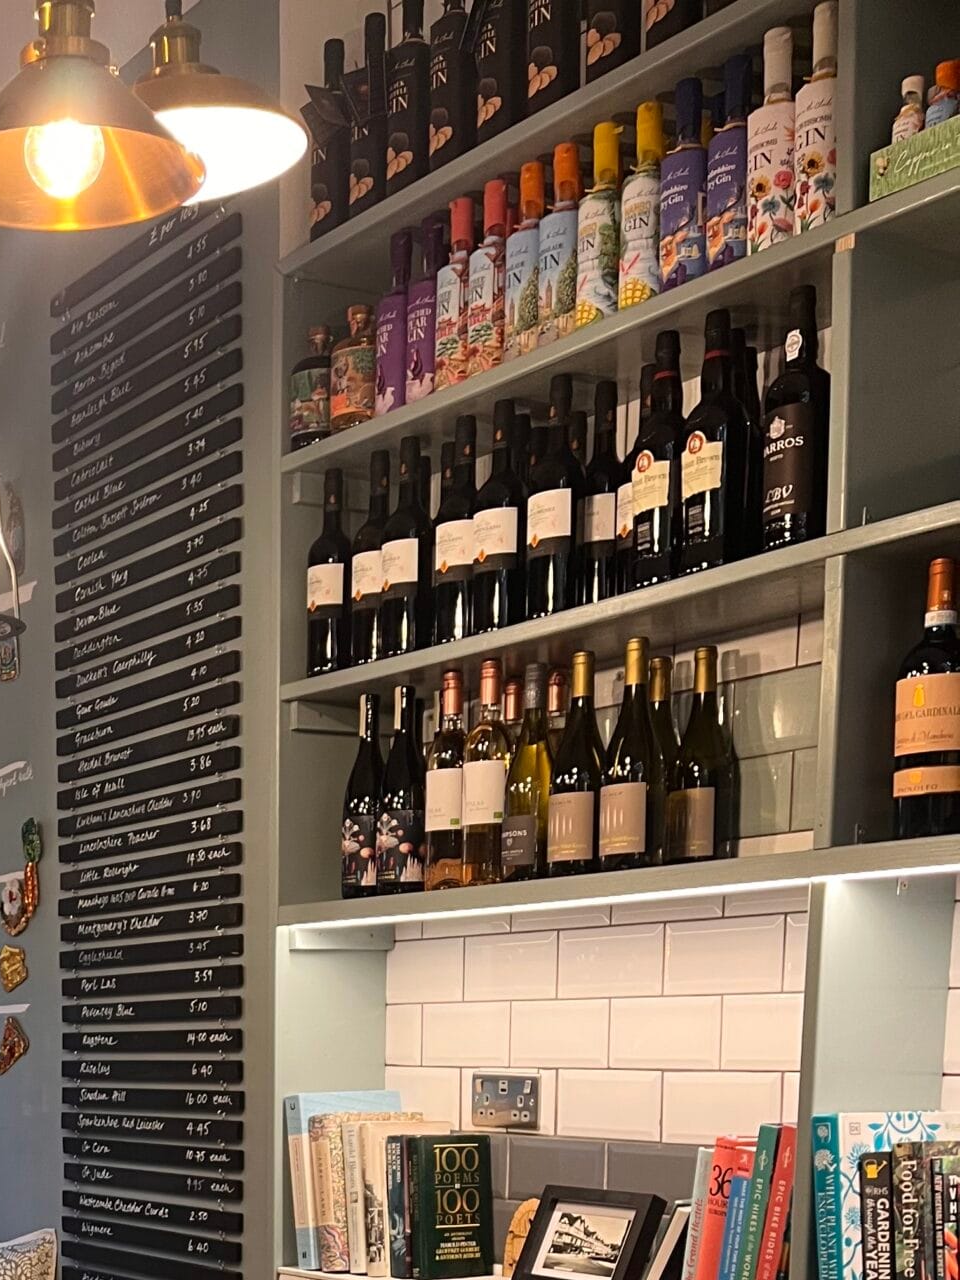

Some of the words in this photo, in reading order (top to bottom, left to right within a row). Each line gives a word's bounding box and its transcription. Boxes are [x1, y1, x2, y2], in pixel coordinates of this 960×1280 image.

[160, 218, 177, 241] per
[624, 215, 650, 232] GIN
[207, 721, 227, 735] each
[207, 848, 231, 860] each
[129, 915, 164, 930] Cheddar
[100, 977, 117, 989] Las
[115, 1003, 135, 1016] Blue
[209, 1033, 233, 1042] each
[111, 1089, 127, 1102] Hill
[212, 1095, 233, 1105] each
[209, 1152, 231, 1162] each
[434, 1147, 479, 1172] 100
[210, 1180, 235, 1193] each
[435, 1172, 480, 1184] POEMS
[710, 1165, 733, 1199] 36
[753, 1178, 764, 1200] EPIC
[901, 1159, 918, 1204] Food
[935, 1174, 943, 1193] NEW
[435, 1188, 480, 1214] 100
[775, 1179, 787, 1203] EPIC
[825, 1175, 836, 1213] WHAT
[873, 1187, 889, 1195] RHS
[144, 1203, 169, 1218] Curds
[436, 1213, 480, 1225] POETS
[749, 1203, 760, 1232] HIKES
[770, 1206, 782, 1228] BIKE
[864, 1198, 875, 1235] through
[902, 1208, 919, 1234] for
[765, 1231, 777, 1260] RIDES
[826, 1215, 837, 1256] PLANT
[867, 1235, 875, 1250] the
[686, 1231, 700, 1266] Grand
[903, 1238, 920, 1278] Free
[936, 1249, 944, 1277] EXPERT
